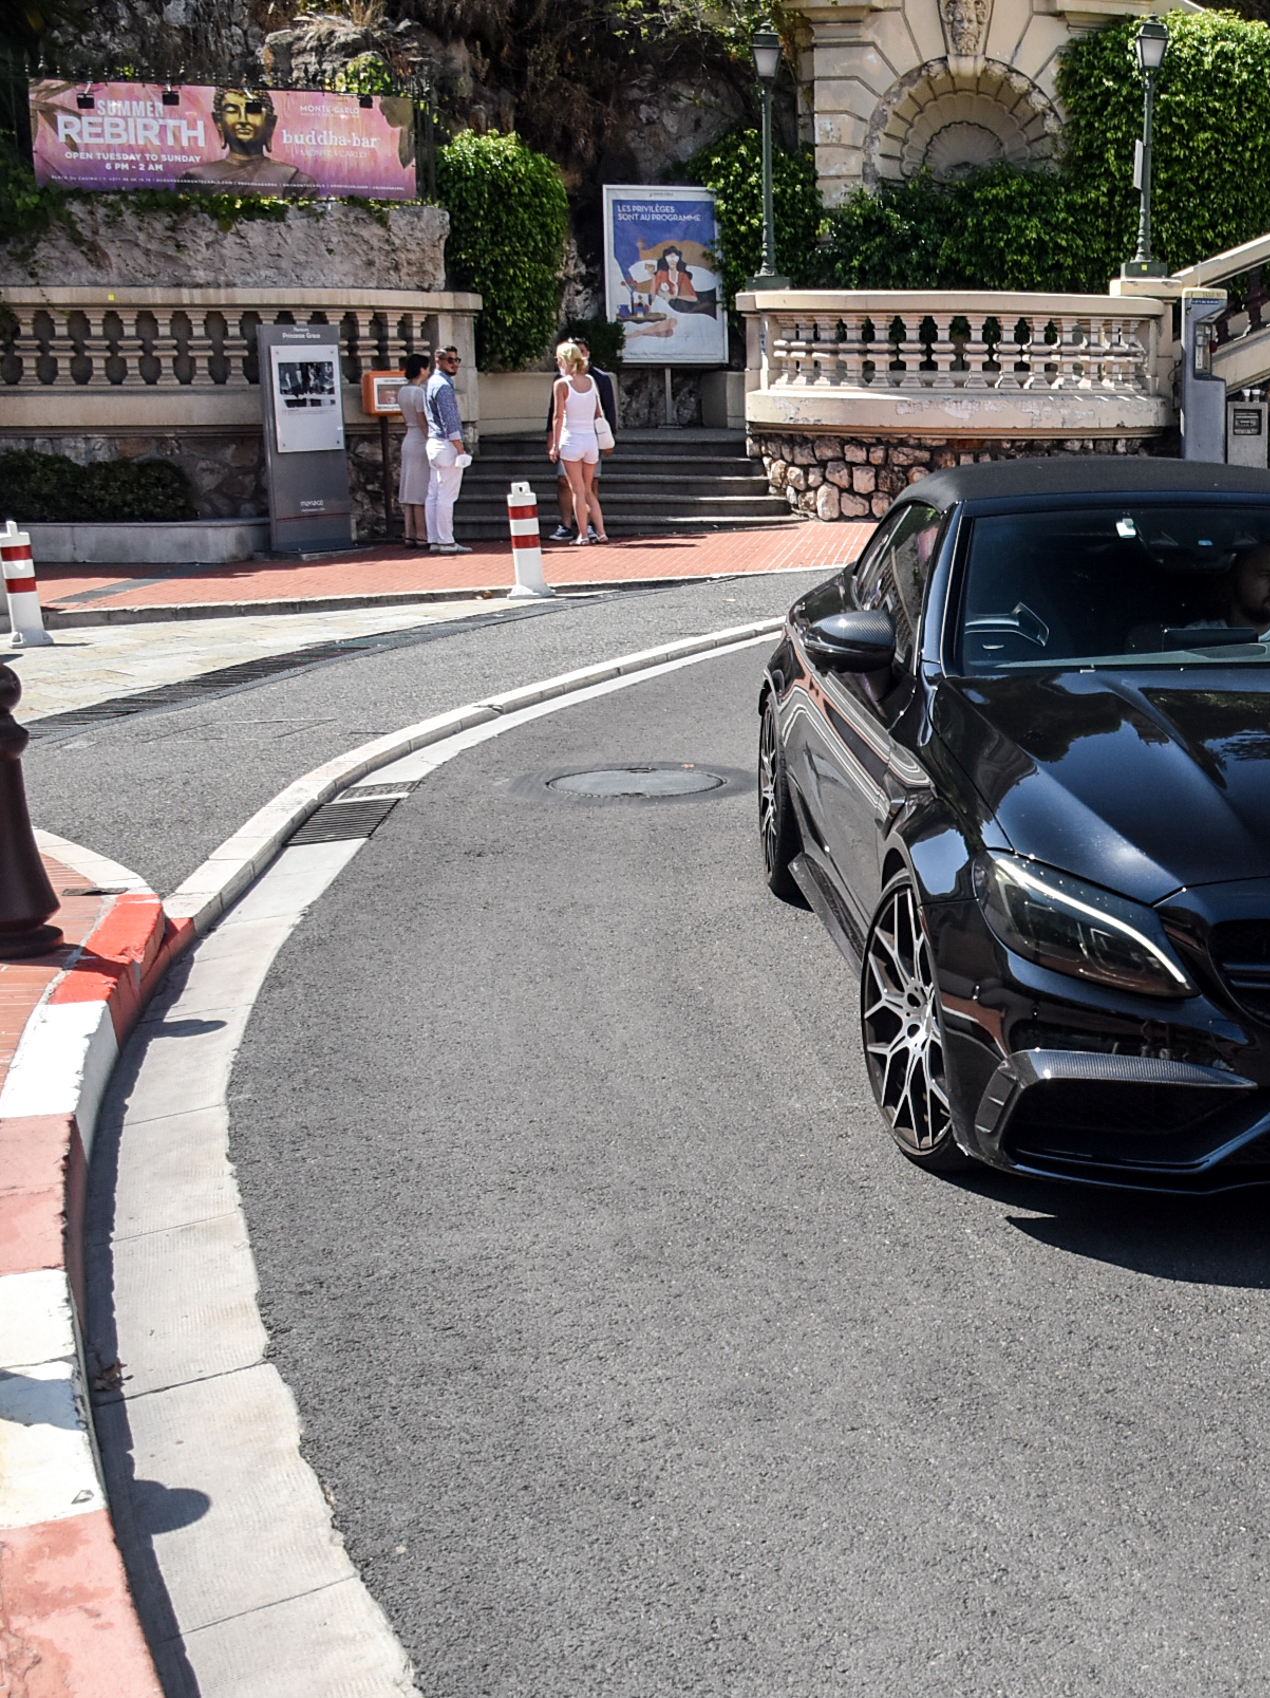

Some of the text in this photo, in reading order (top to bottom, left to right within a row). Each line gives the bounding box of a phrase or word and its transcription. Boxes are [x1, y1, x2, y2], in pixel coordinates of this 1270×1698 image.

[97, 100, 164, 117] SUMMER
[57, 115, 205, 148] REBIRTH
[282, 129, 377, 148] buddha-bar
[96, 152, 141, 161] TUESDAY
[161, 154, 201, 163] SUNDAY
[632, 203, 675, 213] PRIVILÈGES
